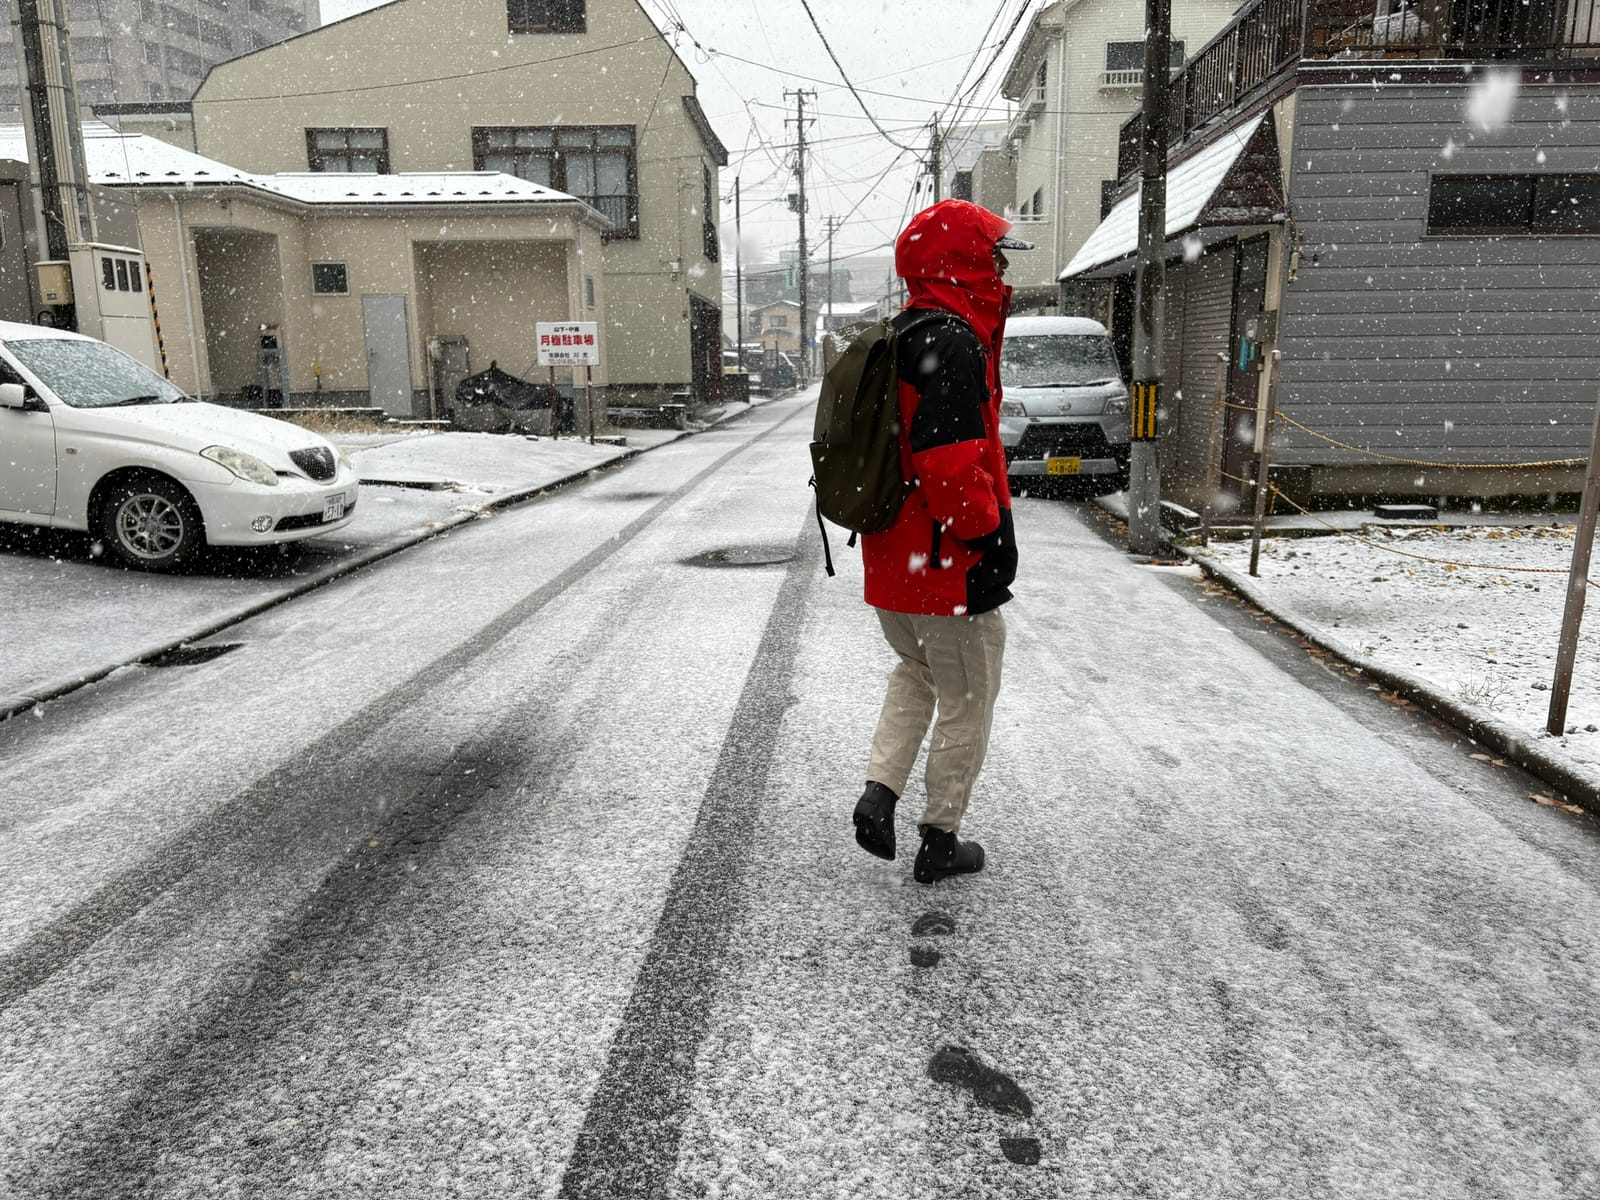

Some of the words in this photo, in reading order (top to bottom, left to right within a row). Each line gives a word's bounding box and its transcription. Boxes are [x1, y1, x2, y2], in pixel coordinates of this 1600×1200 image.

[541, 334, 594, 346] 月極駐車場
